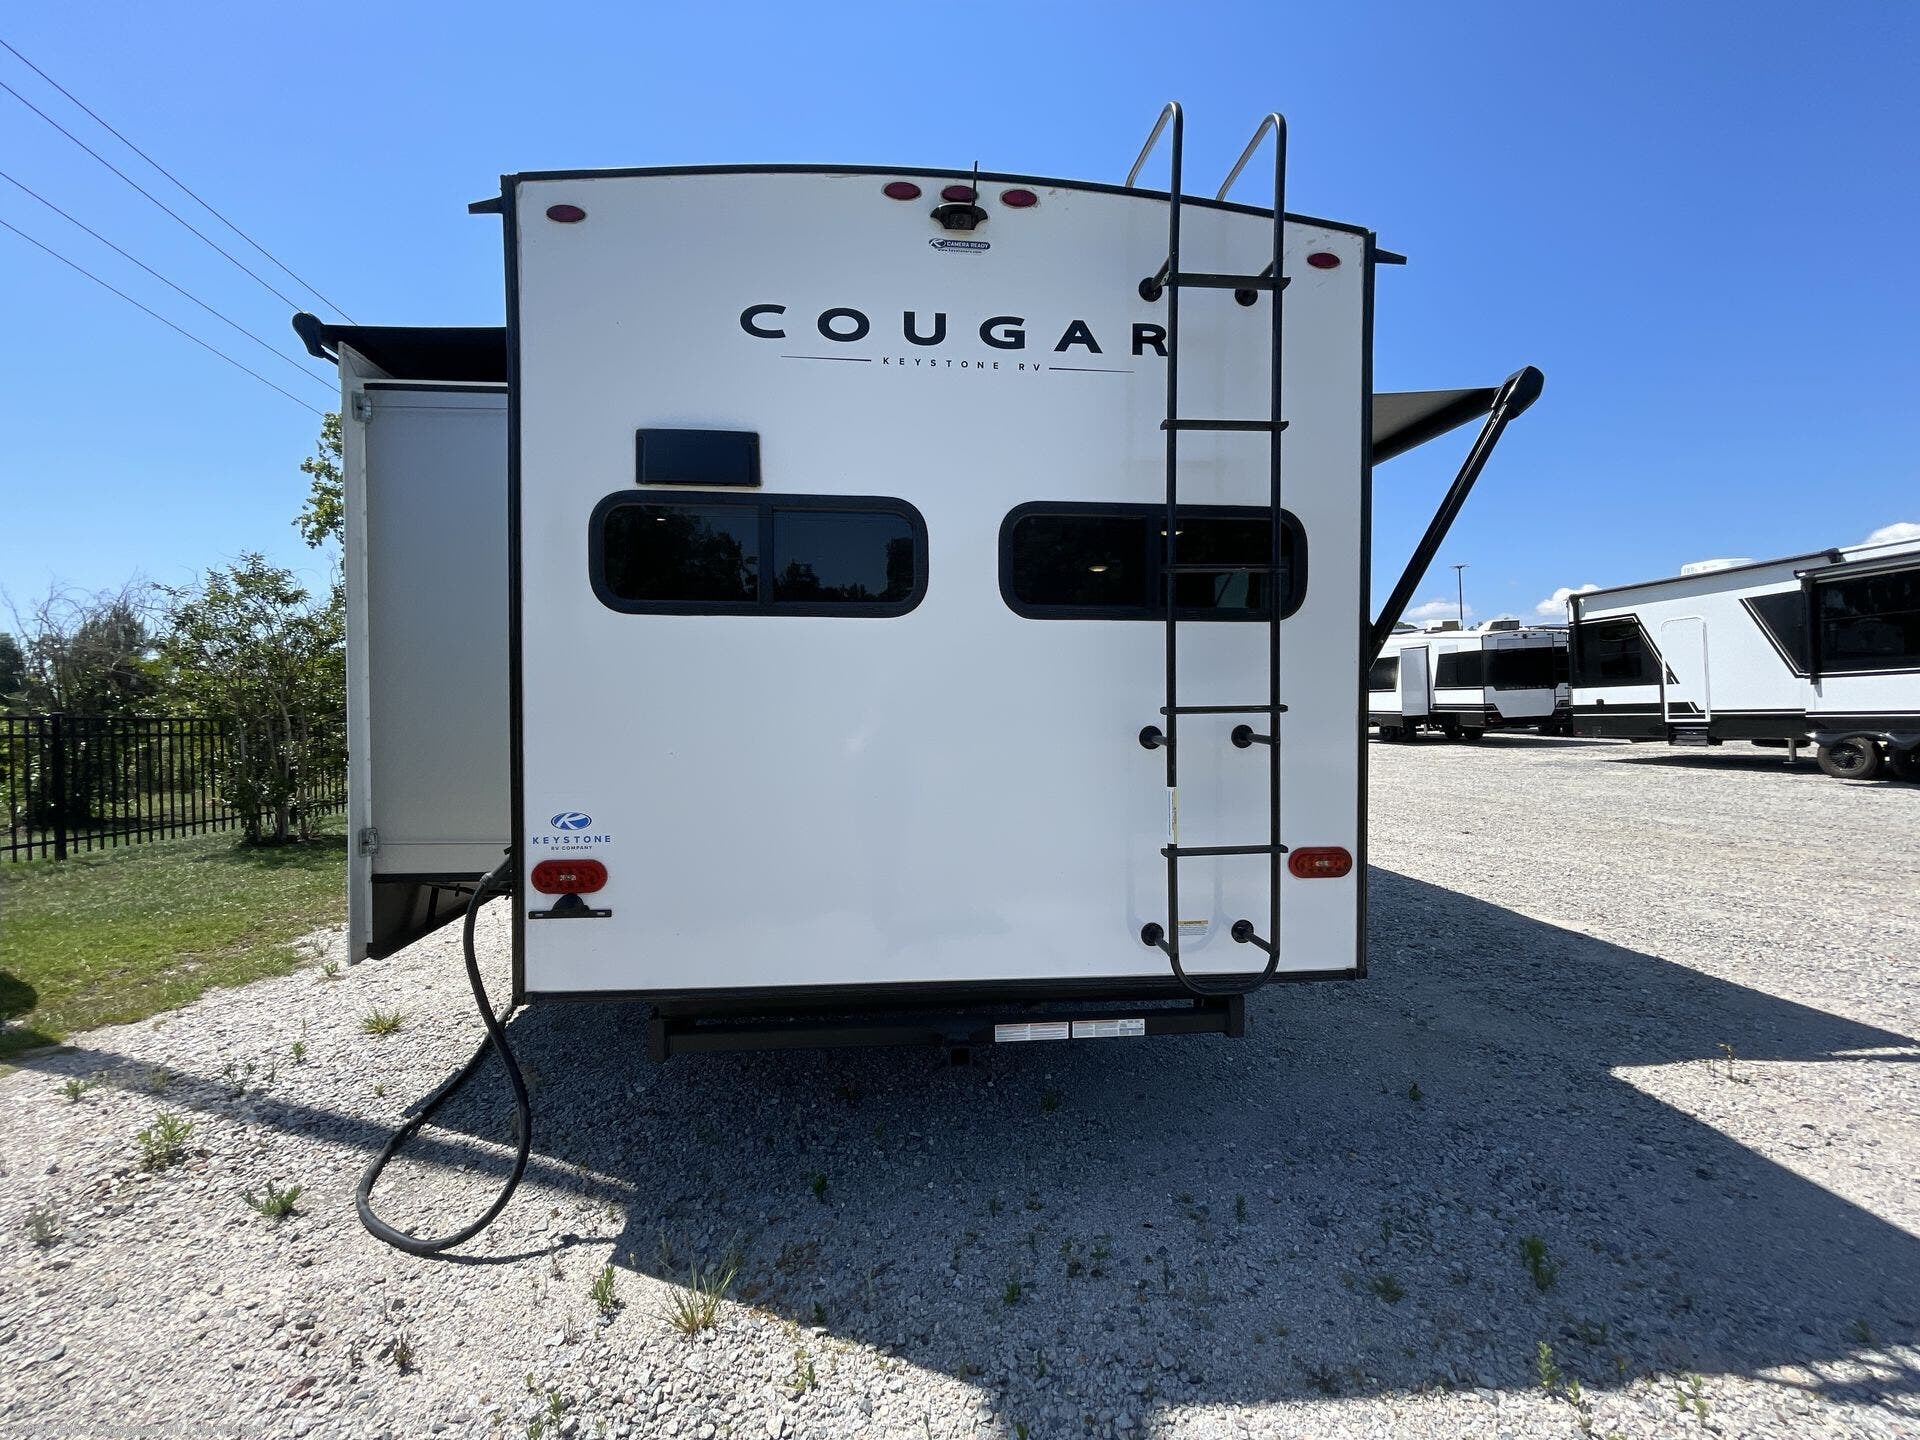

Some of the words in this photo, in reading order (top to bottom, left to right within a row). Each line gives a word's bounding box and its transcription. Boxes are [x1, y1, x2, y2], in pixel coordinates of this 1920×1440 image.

[739, 303, 1169, 357] COUGAR
[882, 356, 999, 371] KEYSTONE
[1018, 362, 1042, 372] RV
[532, 835, 611, 845] KEYSTONE
